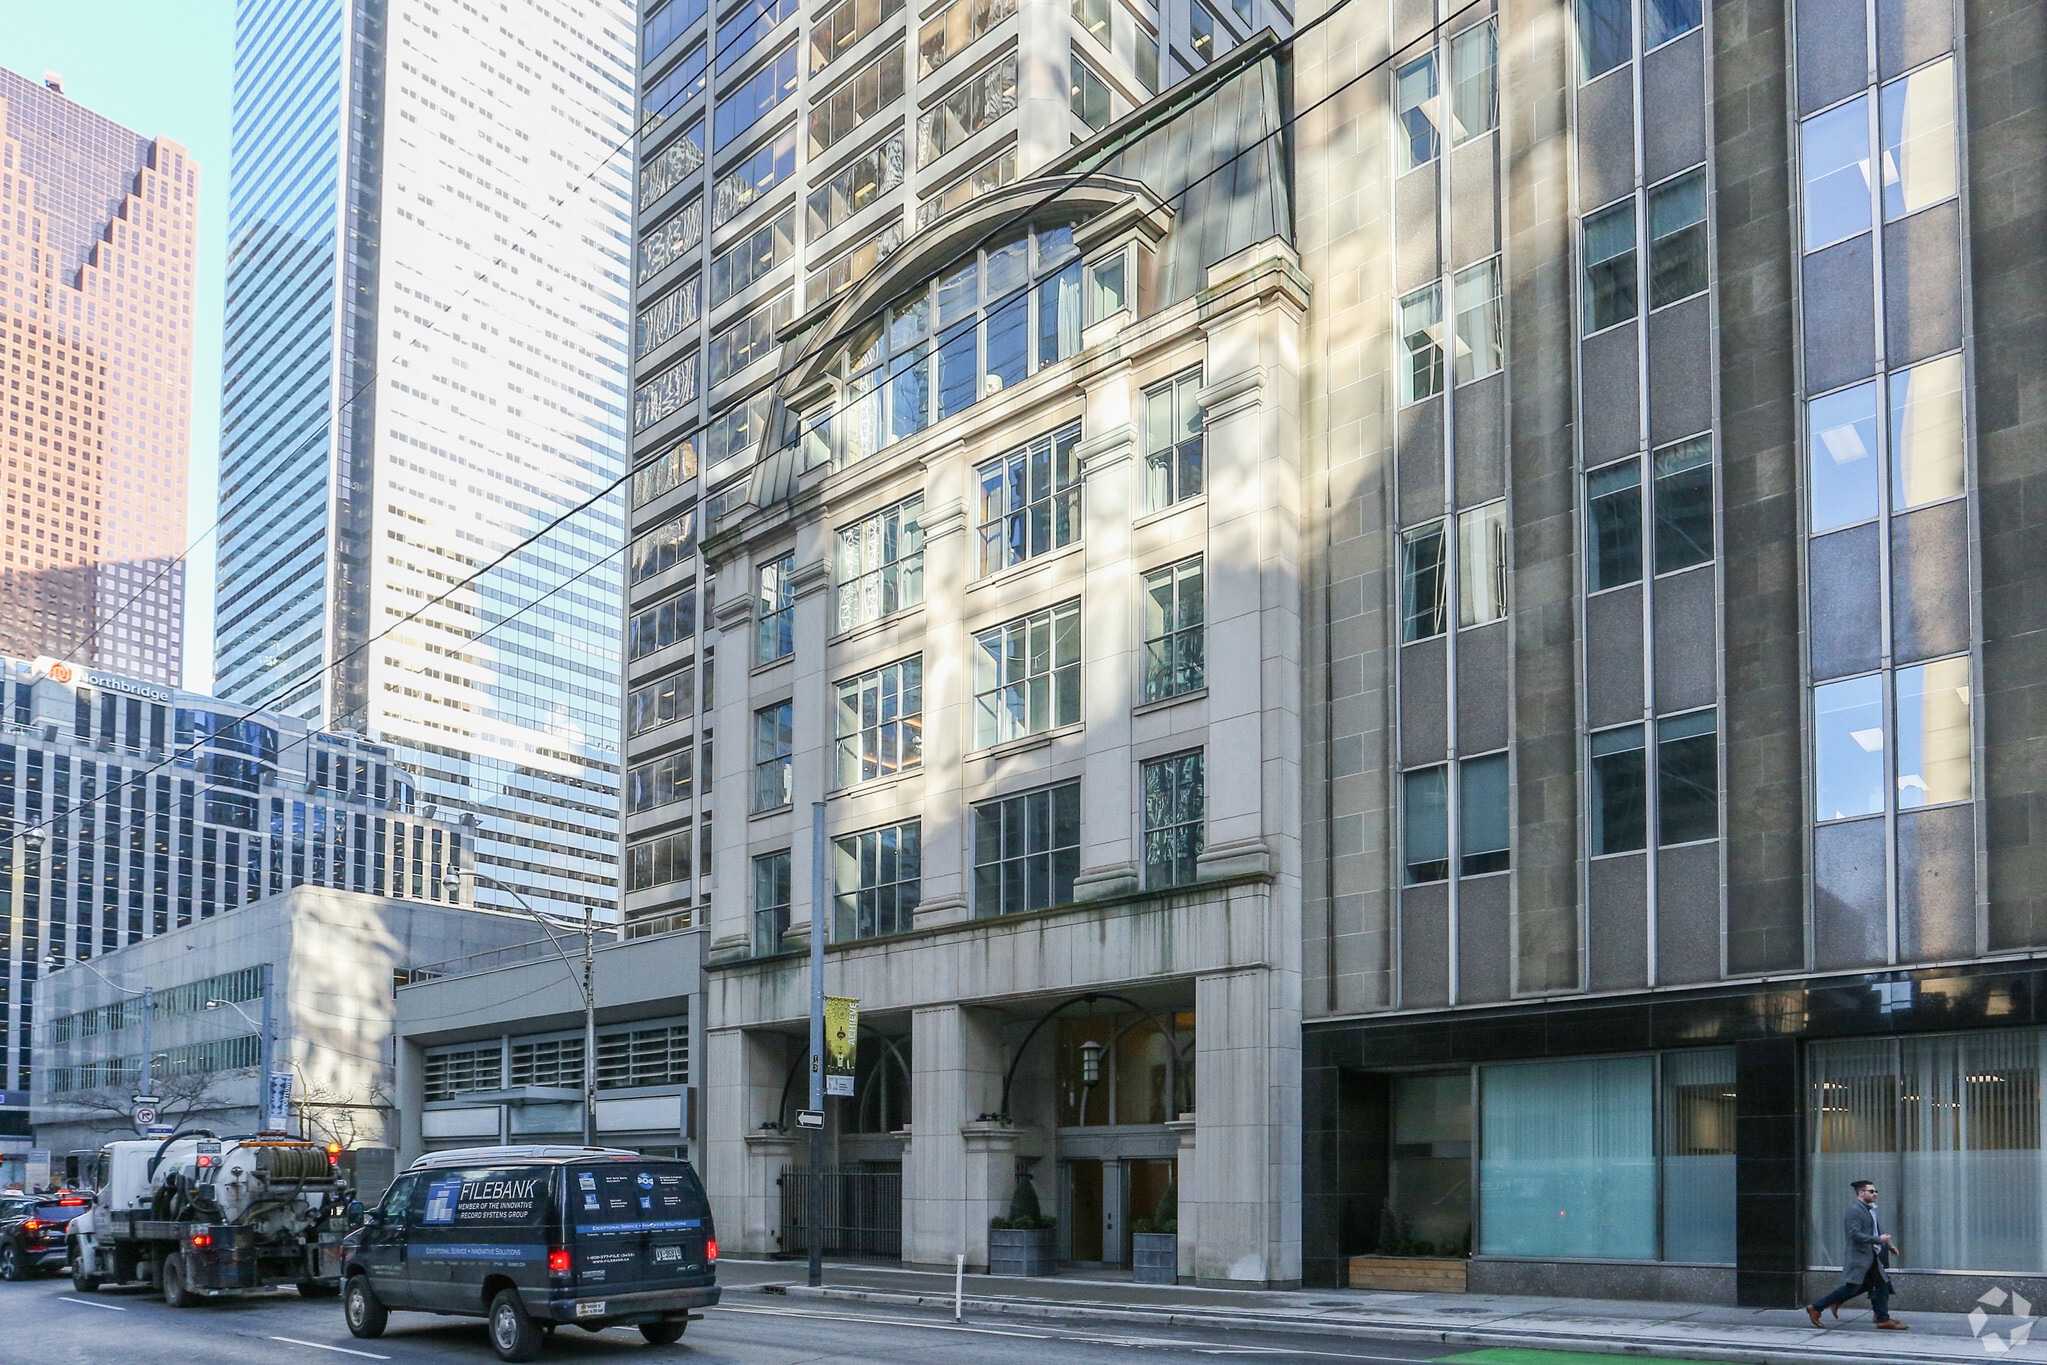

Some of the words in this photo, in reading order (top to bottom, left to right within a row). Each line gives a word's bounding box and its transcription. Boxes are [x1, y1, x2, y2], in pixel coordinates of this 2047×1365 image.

[80, 672, 168, 701] Northbridge
[847, 1001, 859, 1046] ACHIEVE
[460, 1179, 540, 1200] FILEBANK
[458, 1202, 480, 1210] MEMBER
[480, 1202, 488, 1210] OF
[500, 1201, 533, 1209] INNOVATIVE
[461, 1211, 482, 1219] RECORD
[482, 1211, 507, 1219] SYSTEMS
[508, 1210, 529, 1218] GROUP
